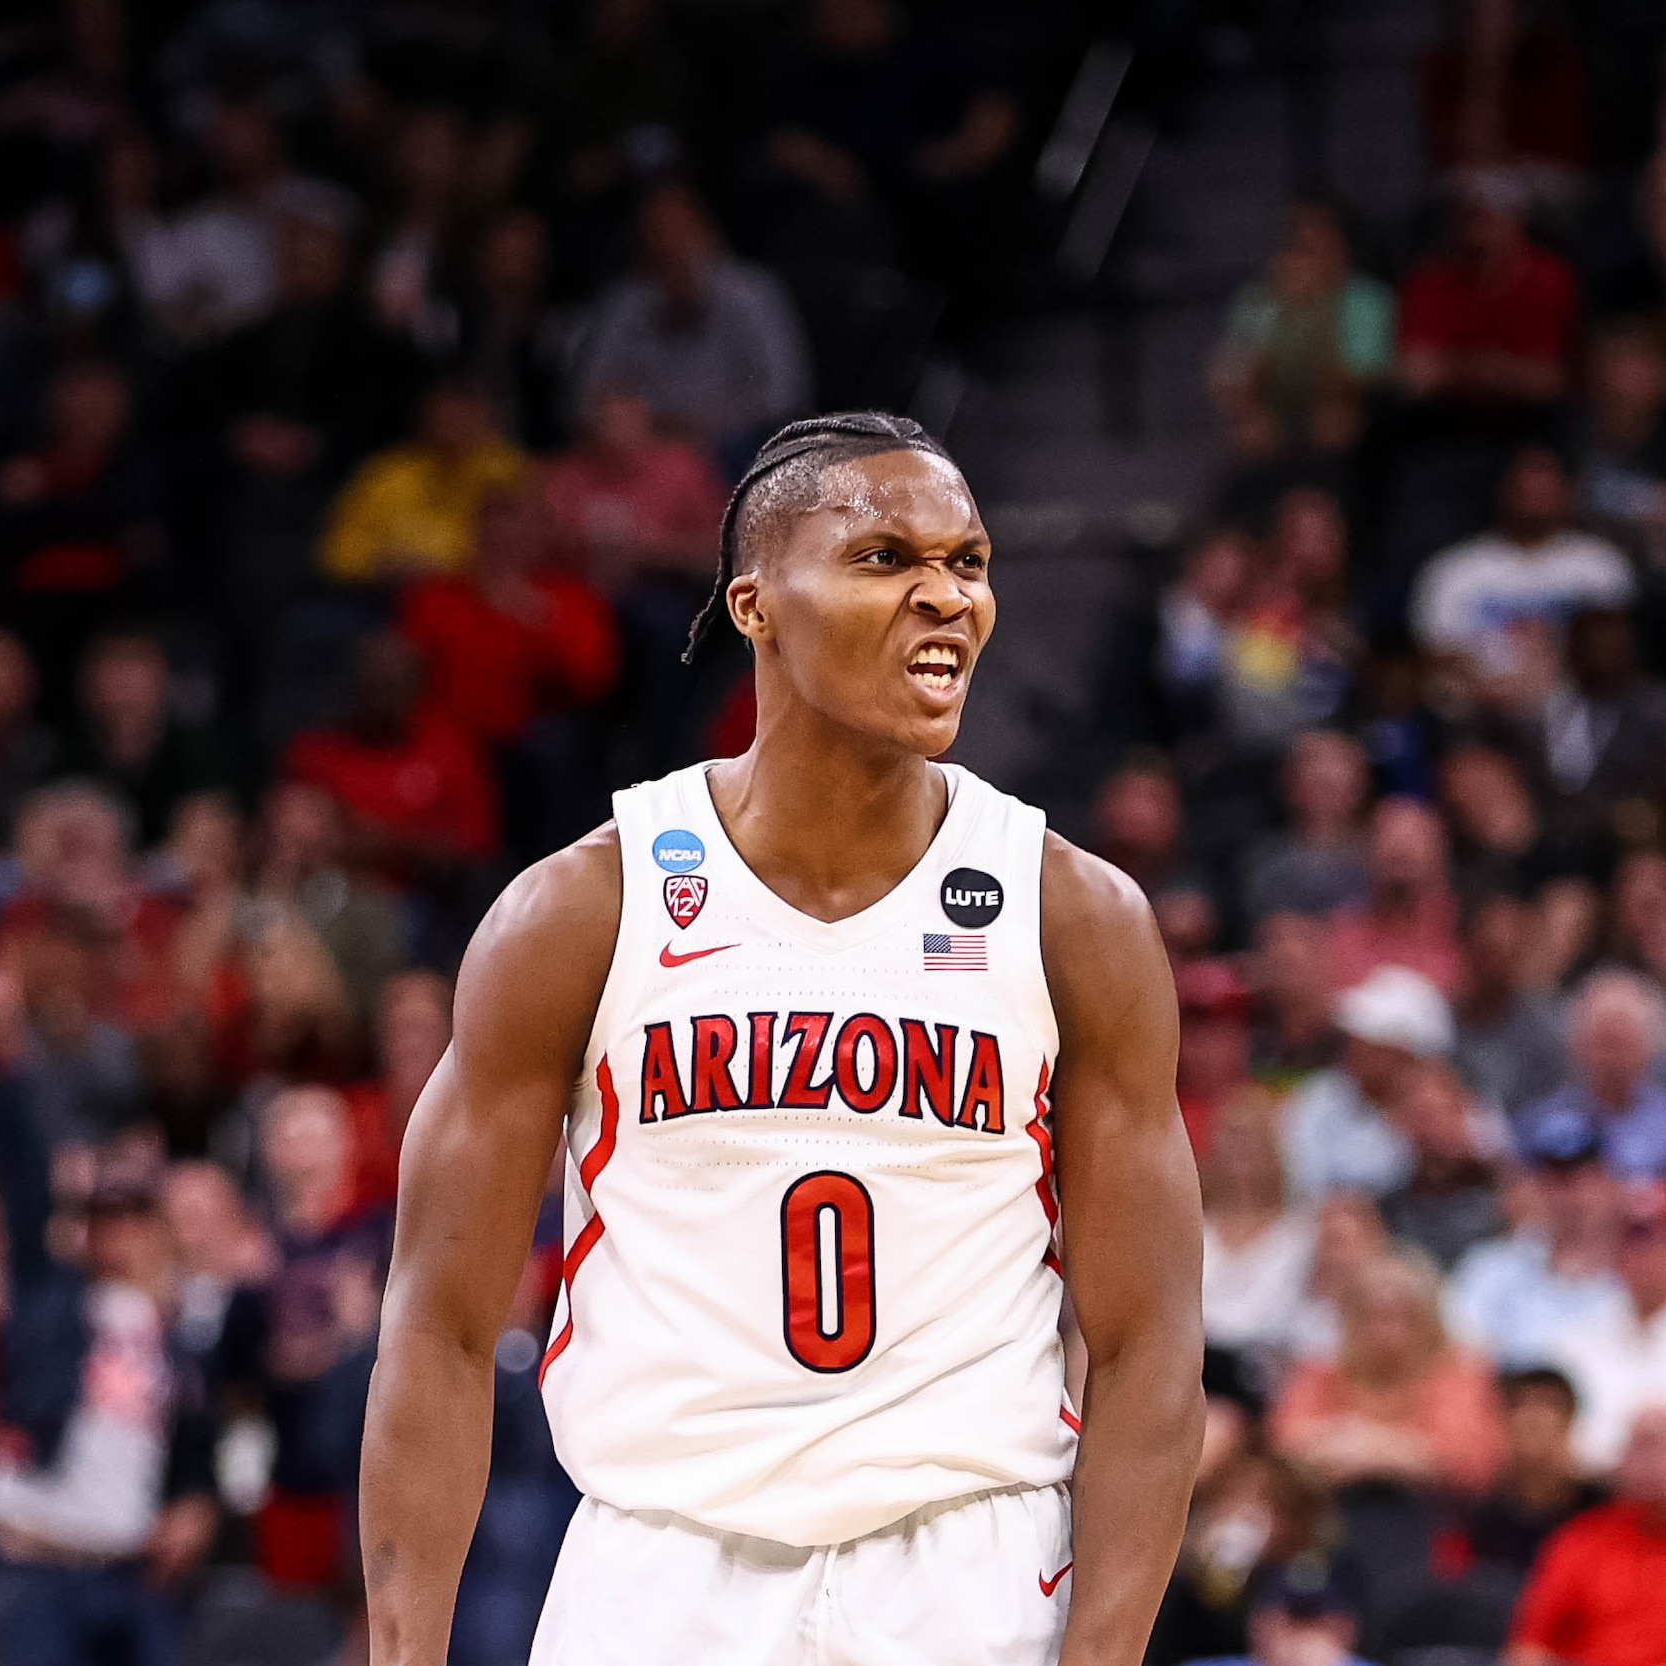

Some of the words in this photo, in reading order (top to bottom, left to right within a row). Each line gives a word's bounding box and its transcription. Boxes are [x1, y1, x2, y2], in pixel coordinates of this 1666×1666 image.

[659, 848, 702, 862] NCAA
[666, 876, 706, 905] PAC
[945, 887, 999, 906] LUTE
[673, 898, 694, 917] 12
[639, 1011, 1005, 1134] ARIZONA
[779, 1169, 877, 1375] 0
